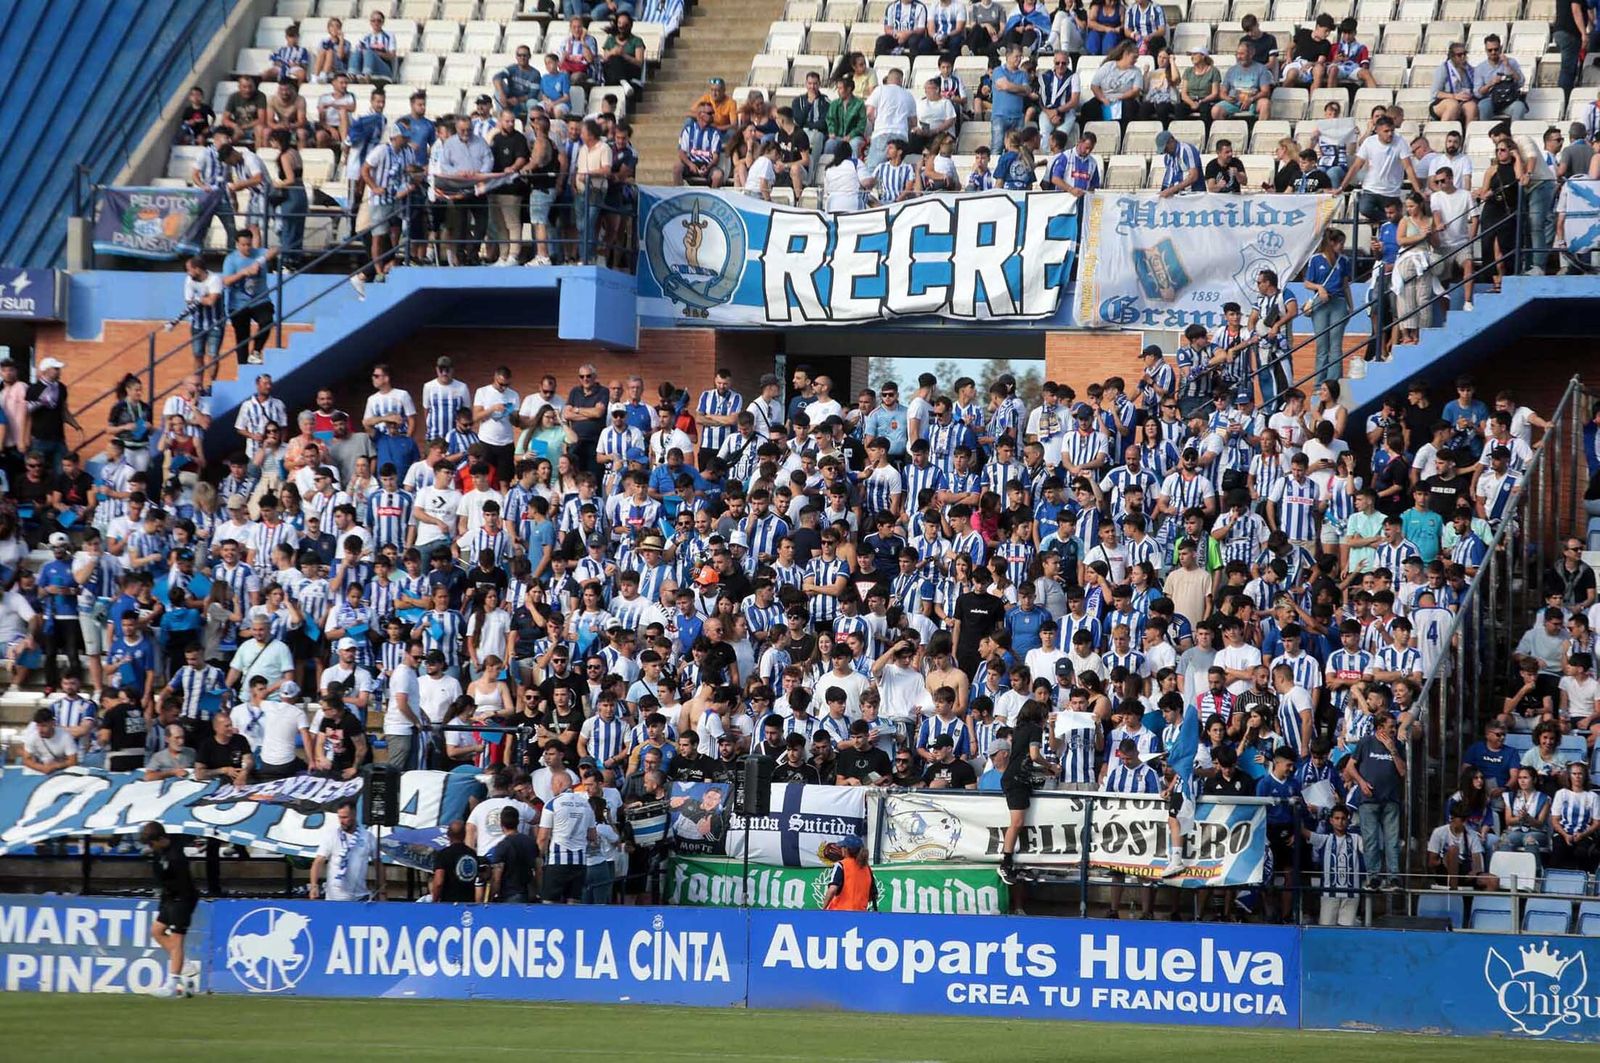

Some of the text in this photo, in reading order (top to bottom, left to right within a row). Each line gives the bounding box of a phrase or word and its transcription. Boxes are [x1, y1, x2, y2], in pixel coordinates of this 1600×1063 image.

[1116, 197, 1306, 236] Humilde
[761, 190, 1079, 323] RECRE
[1426, 620, 1438, 645] 4
[788, 812, 857, 836] Suicida
[0, 901, 162, 948] MARTÍ
[325, 924, 731, 982] ATRACCIONES LA CINTA
[763, 922, 1285, 986] Autoparts Huelva
[946, 982, 1288, 1016] CREA TU FRANQUICIA
